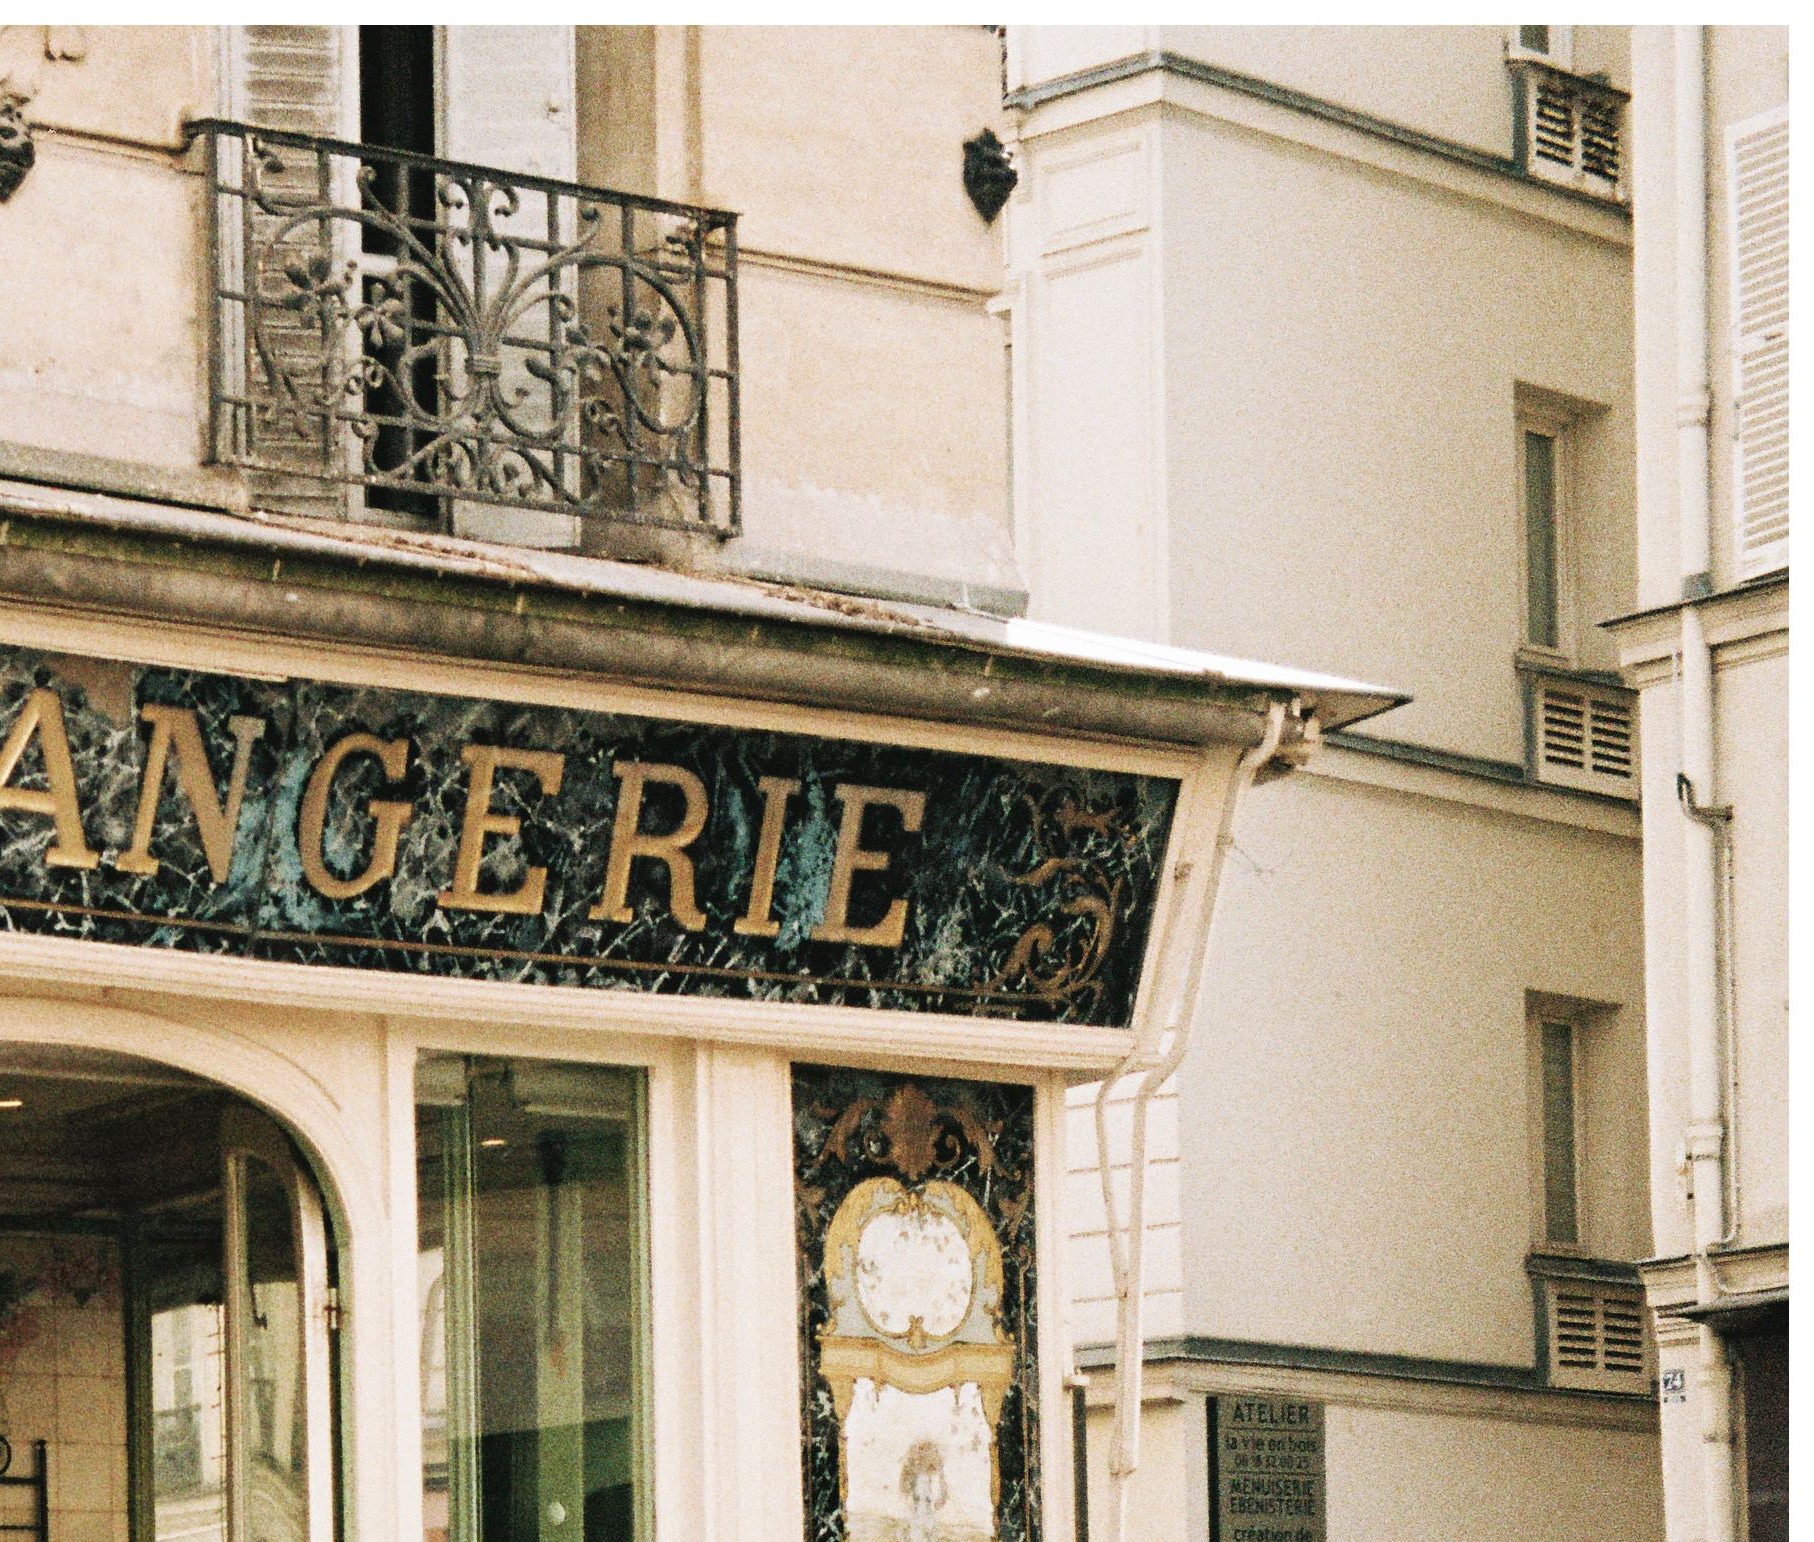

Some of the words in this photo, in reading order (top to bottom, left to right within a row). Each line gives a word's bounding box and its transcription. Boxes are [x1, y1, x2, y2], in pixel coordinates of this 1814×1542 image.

[1232, 1403, 1310, 1424] ATELIER
[1268, 1438, 1285, 1452] en
[1229, 1478, 1315, 1498] MENUISERIE
